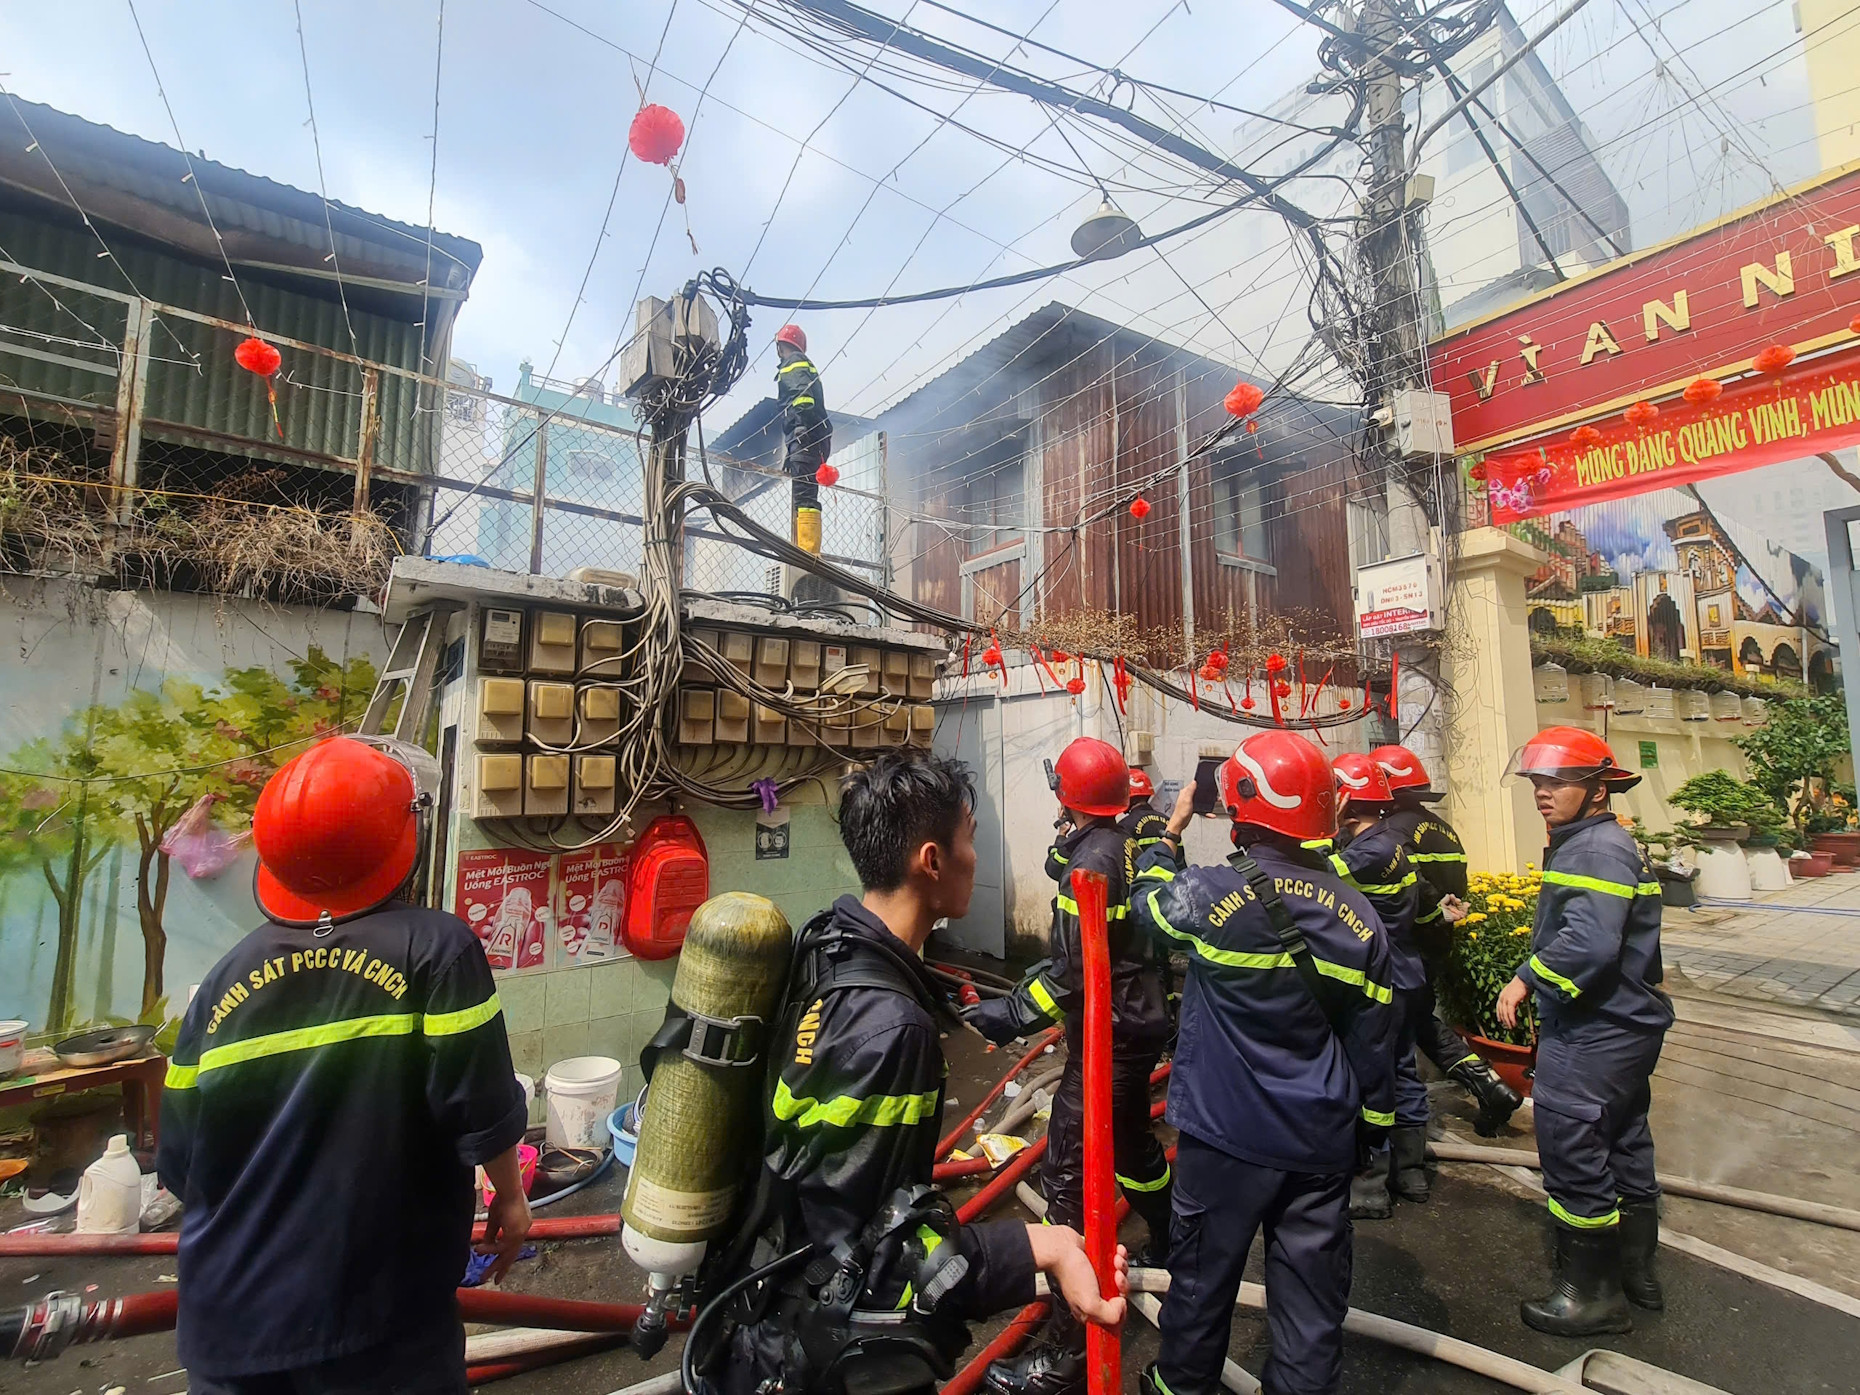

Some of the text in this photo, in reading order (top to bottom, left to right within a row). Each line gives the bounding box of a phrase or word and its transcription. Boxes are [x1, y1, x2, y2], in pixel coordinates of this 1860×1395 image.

[1467, 333, 1545, 399] VÌ
[1580, 289, 1691, 365] AN
[1678, 411, 1748, 465] QUANG
[493, 871, 545, 886] EASTROC
[1208, 890, 1246, 927] CẢNH
[1274, 877, 1314, 899] PCCC
[1317, 887, 1336, 910] VÀ
[1337, 903, 1374, 942] CNCH
[249, 957, 285, 990] SÁT
[291, 947, 341, 972] PCCC
[342, 948, 368, 975] VÀ
[363, 958, 408, 1000] CNCH
